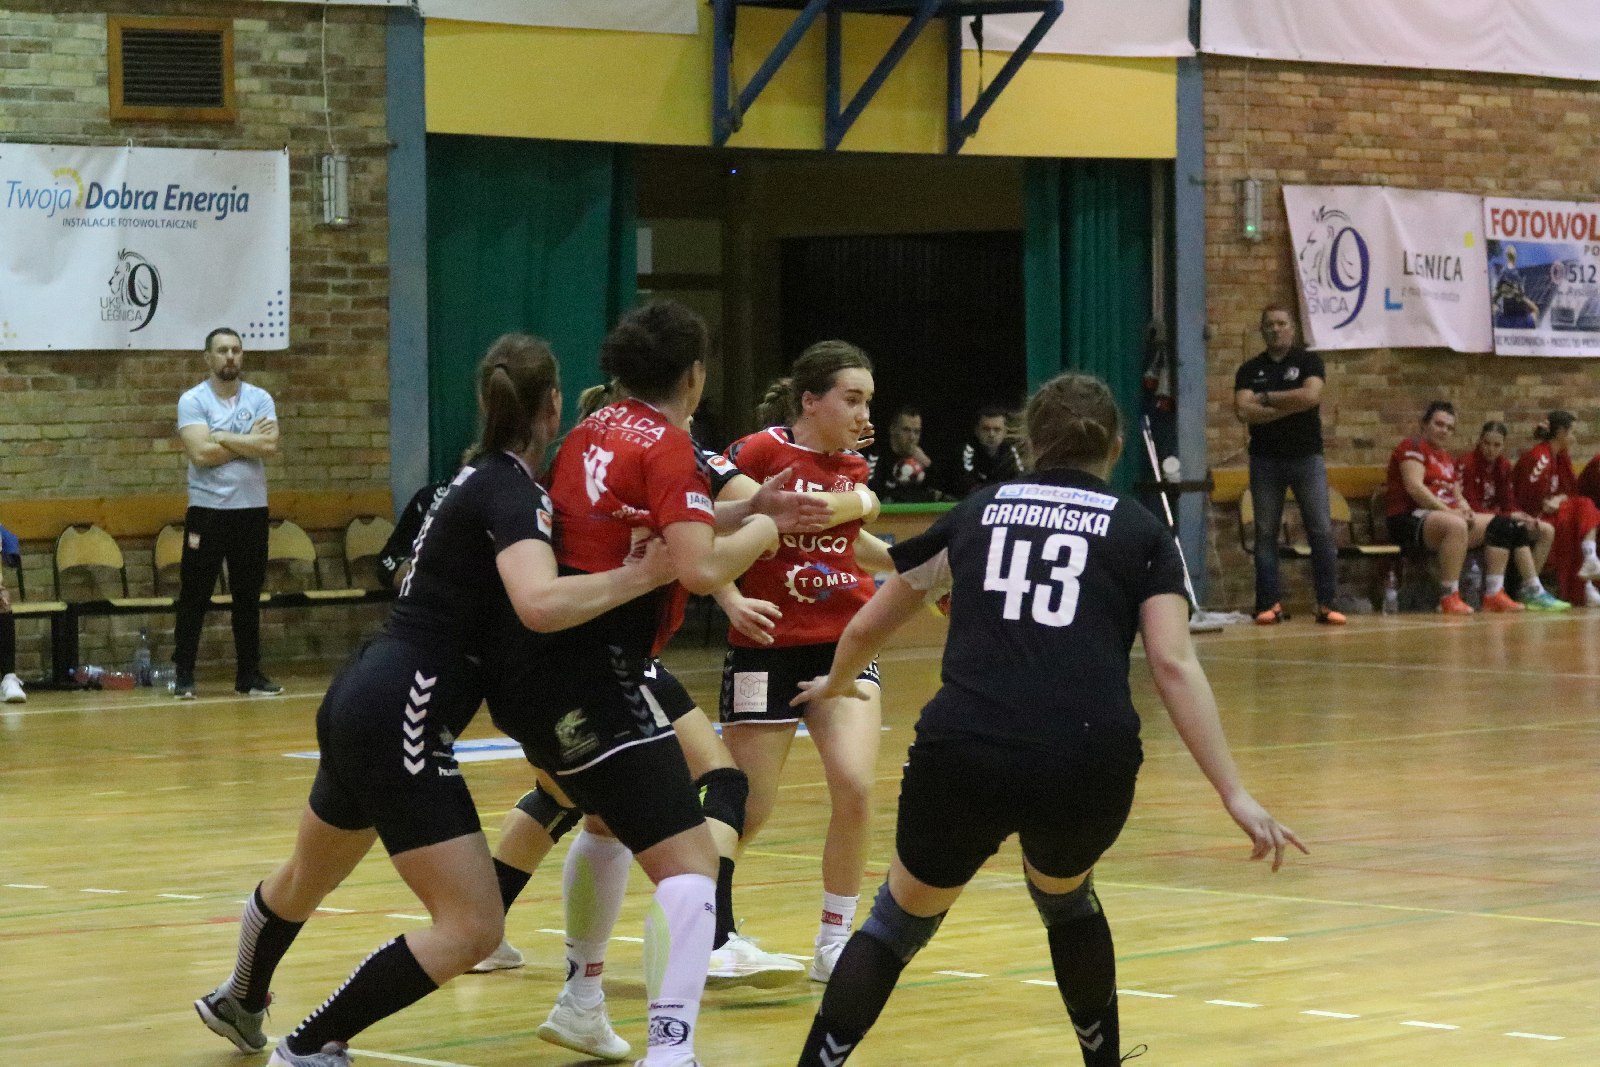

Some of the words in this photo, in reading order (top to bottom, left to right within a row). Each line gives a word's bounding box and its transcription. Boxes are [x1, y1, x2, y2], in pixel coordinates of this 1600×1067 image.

[6, 180, 72, 218] Twoja
[85, 181, 158, 211] Dobra
[163, 183, 249, 221] Energia
[62, 217, 116, 228] INSTALACJE
[118, 217, 198, 229] FOTOWOLTAICZNE
[1490, 208, 1600, 242] FOTOWOL
[1567, 264, 1597, 284] 512
[101, 309, 142, 321] LEGNICA
[1024, 486, 1114, 506] BetaMed
[981, 503, 1111, 537] GRABIŃSKA
[983, 526, 1089, 627] 43
